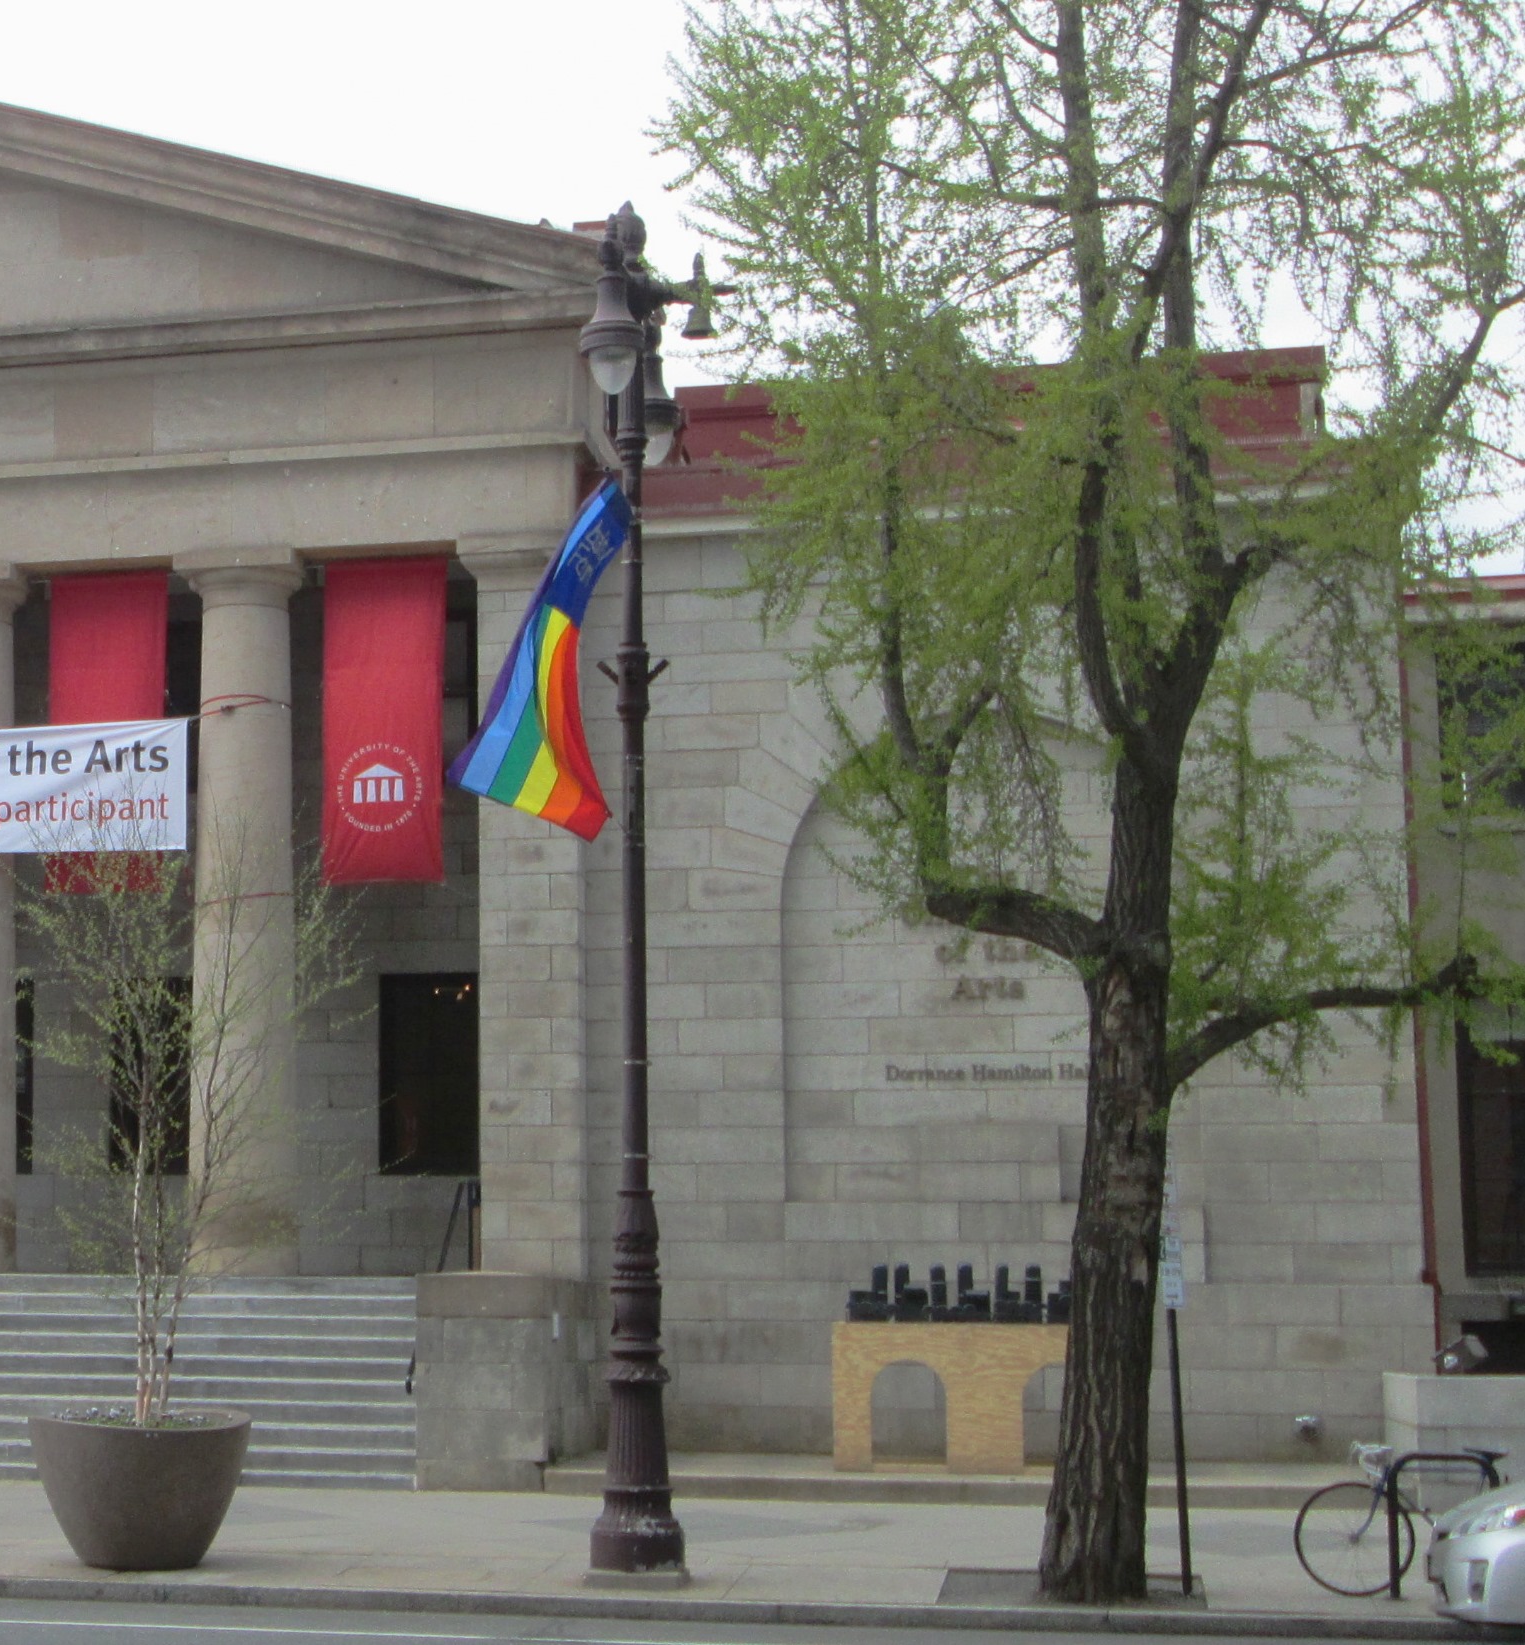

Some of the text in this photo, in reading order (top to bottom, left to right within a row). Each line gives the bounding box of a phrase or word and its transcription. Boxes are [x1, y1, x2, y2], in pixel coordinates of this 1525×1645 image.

[8, 740, 72, 776] the
[84, 739, 170, 774] Arts
[339, 743, 390, 780] UNIVERSITY
[393, 746, 406, 756] OF
[406, 755, 421, 774] THE
[414, 776, 423, 801] ARTS
[344, 812, 382, 832] FOUNDED
[384, 822, 394, 831] IN
[951, 974, 1026, 1000] Arts
[884, 1062, 1090, 1082] Dorrance Hamilton Hal
